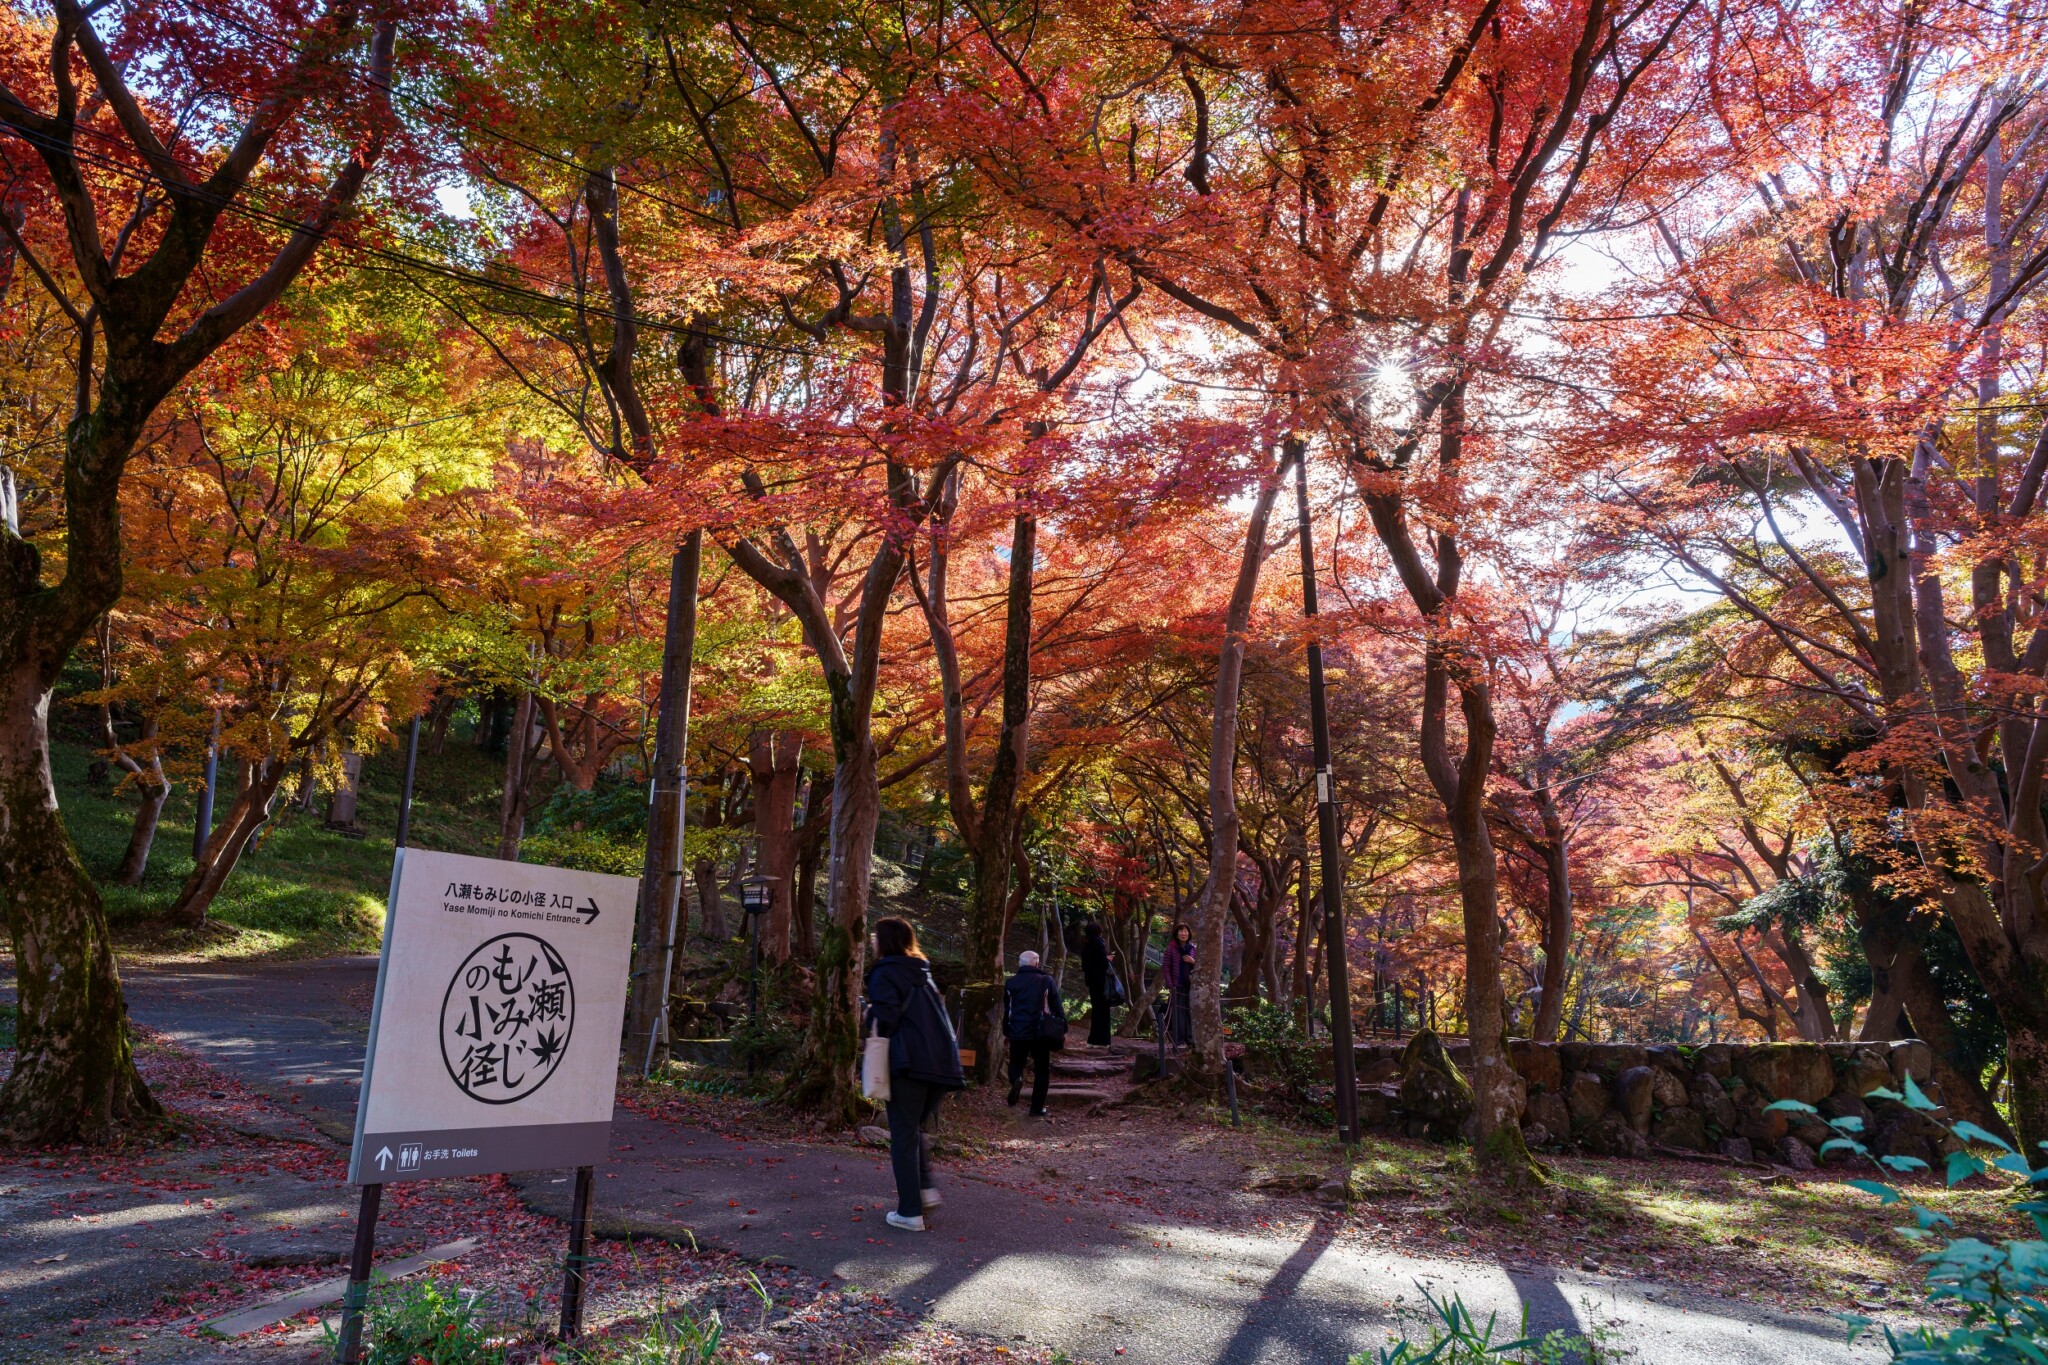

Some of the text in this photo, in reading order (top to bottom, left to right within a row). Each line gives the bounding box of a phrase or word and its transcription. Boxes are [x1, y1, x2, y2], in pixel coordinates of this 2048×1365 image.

[443, 902, 581, 924] Yase Momiji no Komichi Entrance
[445, 883, 573, 909] 八瀬もみじの小径 入口
[522, 943, 566, 1023] 八瀬
[454, 965, 504, 1090] の小径
[492, 943, 530, 1089] もみじ
[424, 1148, 478, 1160] お手洗 Toilets
